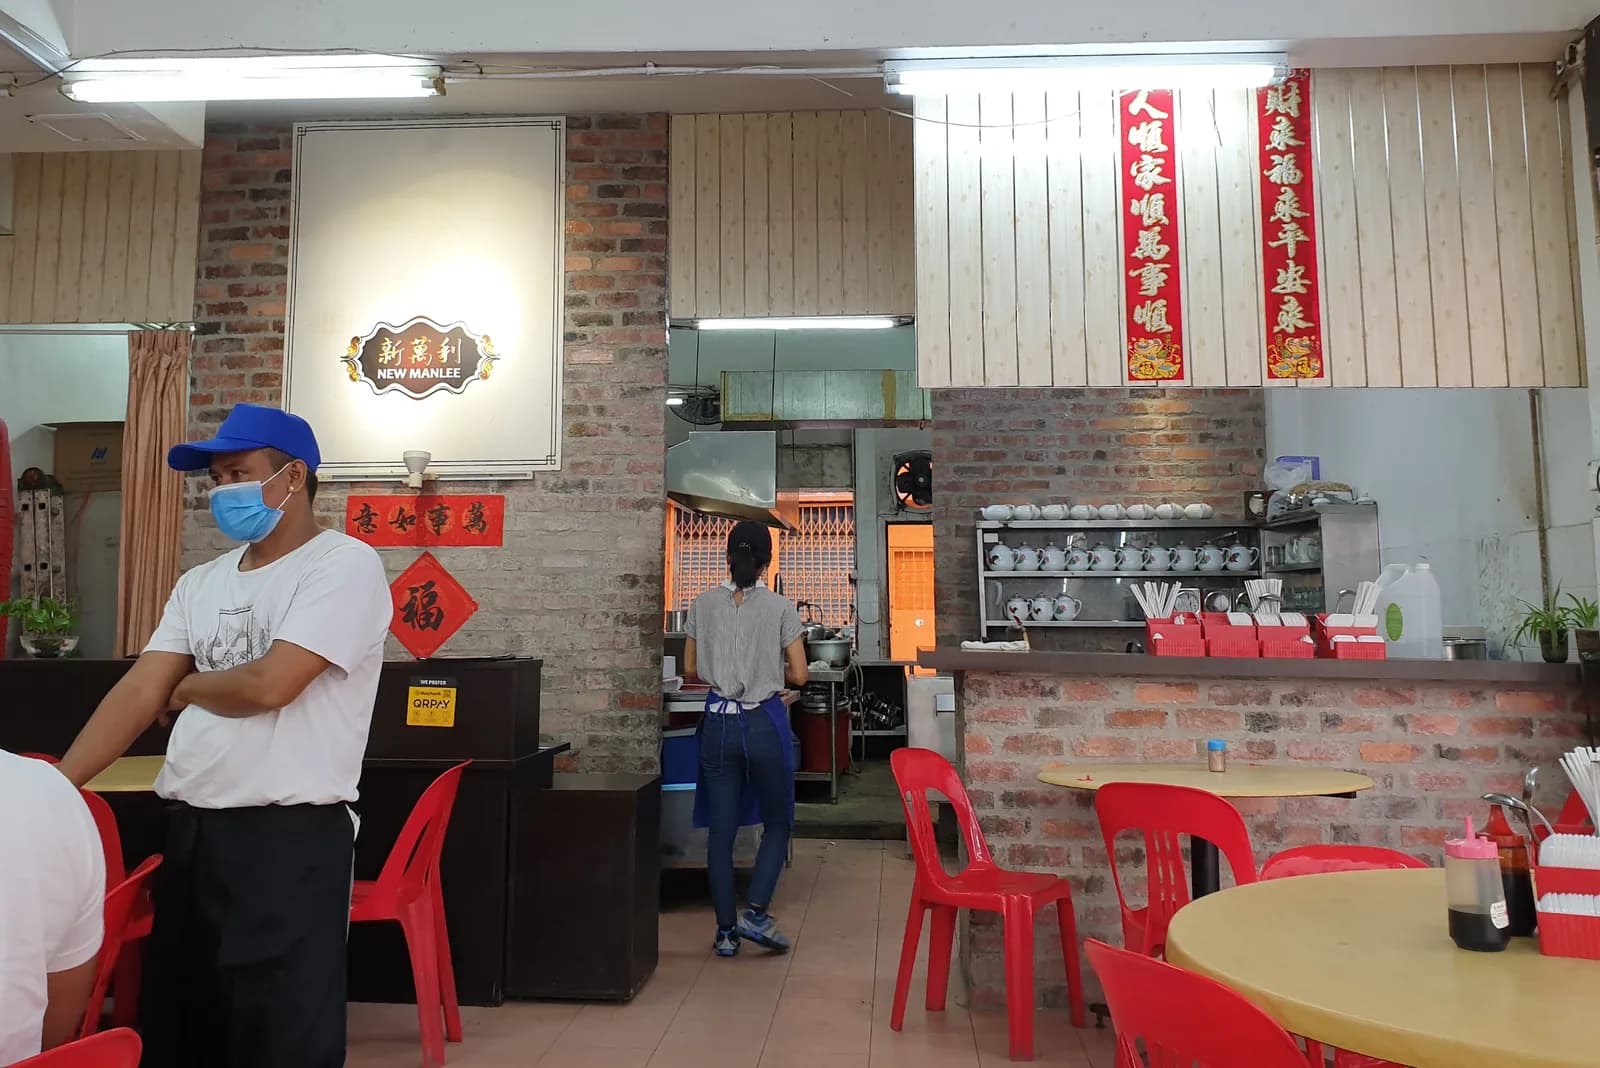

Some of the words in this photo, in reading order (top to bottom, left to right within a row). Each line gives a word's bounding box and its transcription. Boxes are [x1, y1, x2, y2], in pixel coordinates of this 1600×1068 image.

[377, 336, 462, 366] 新萬利
[377, 368, 407, 379] NEW
[409, 367, 462, 379] MANLEE
[400, 580, 445, 631] 福
[413, 698, 450, 709] QRPAY
